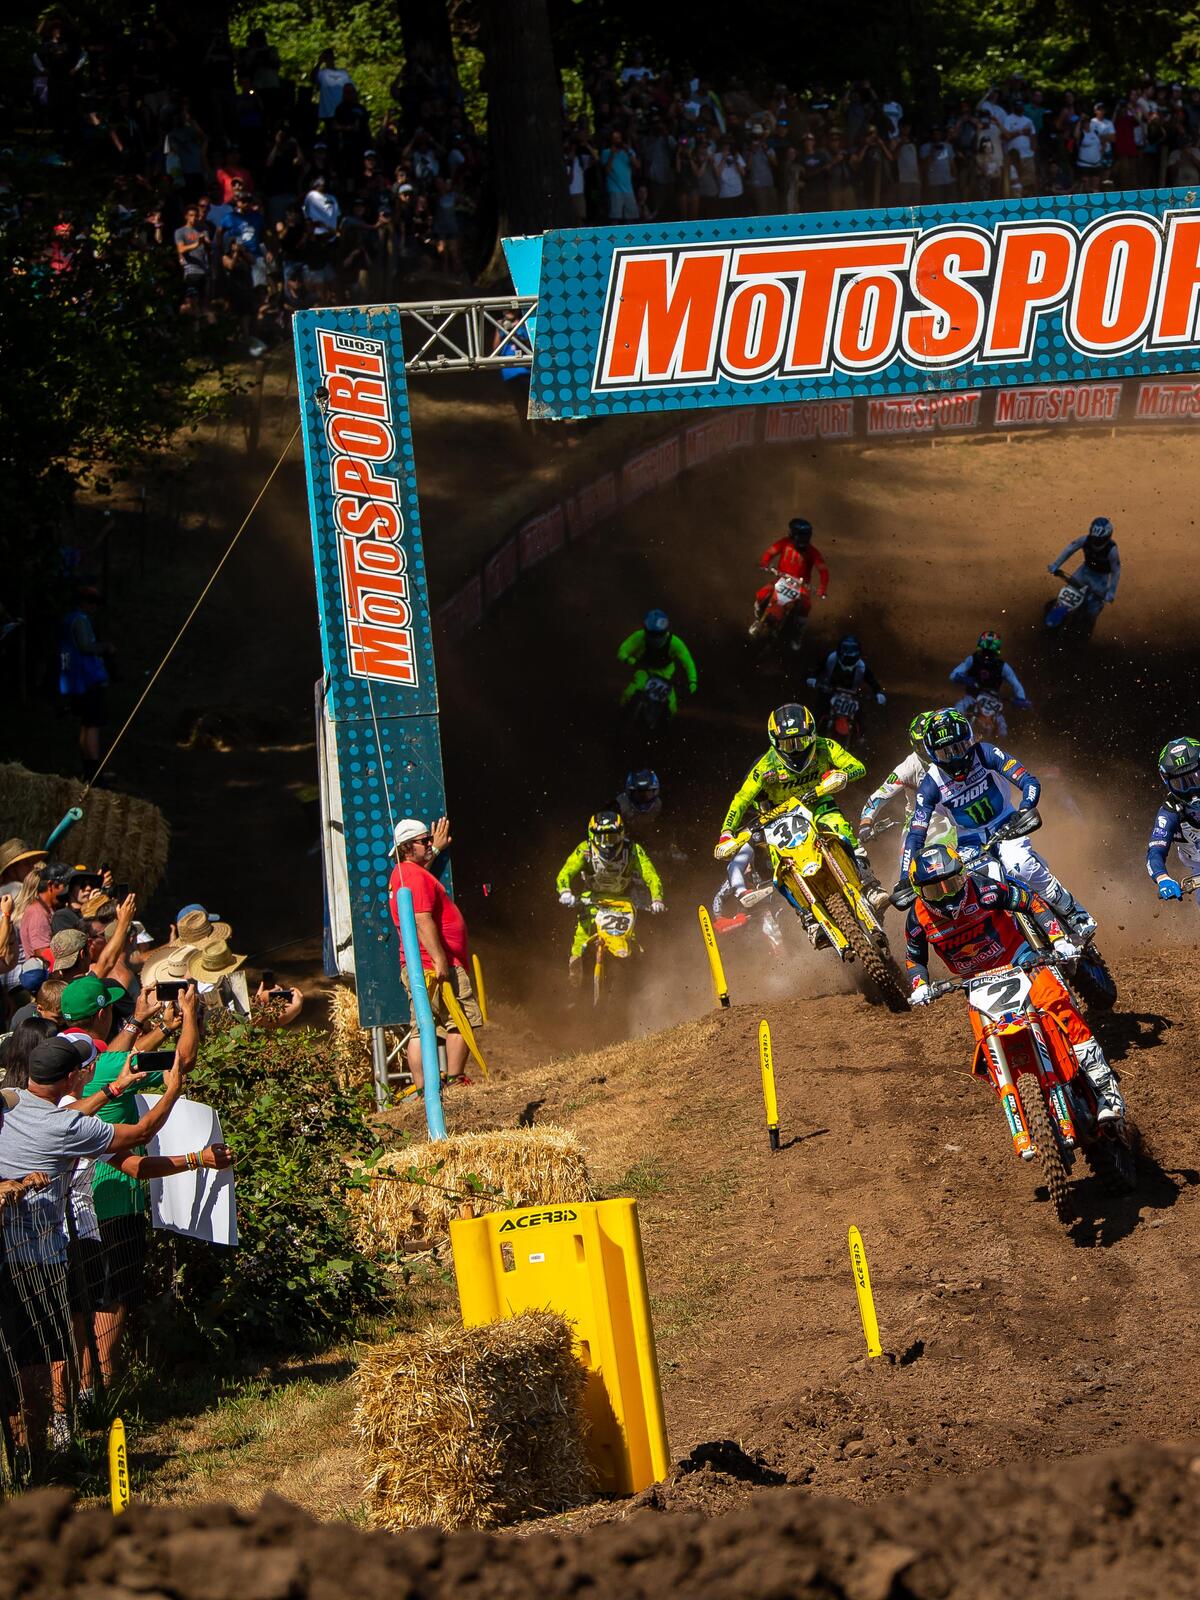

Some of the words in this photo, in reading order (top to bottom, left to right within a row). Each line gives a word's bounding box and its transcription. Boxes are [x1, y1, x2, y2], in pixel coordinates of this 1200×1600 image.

[336, 336, 382, 353] .com
[951, 780, 989, 808] THOR
[772, 815, 810, 850] 34
[977, 941, 1001, 960] Bull
[986, 977, 1021, 1013] 2
[498, 1209, 578, 1233] ACERBIS
